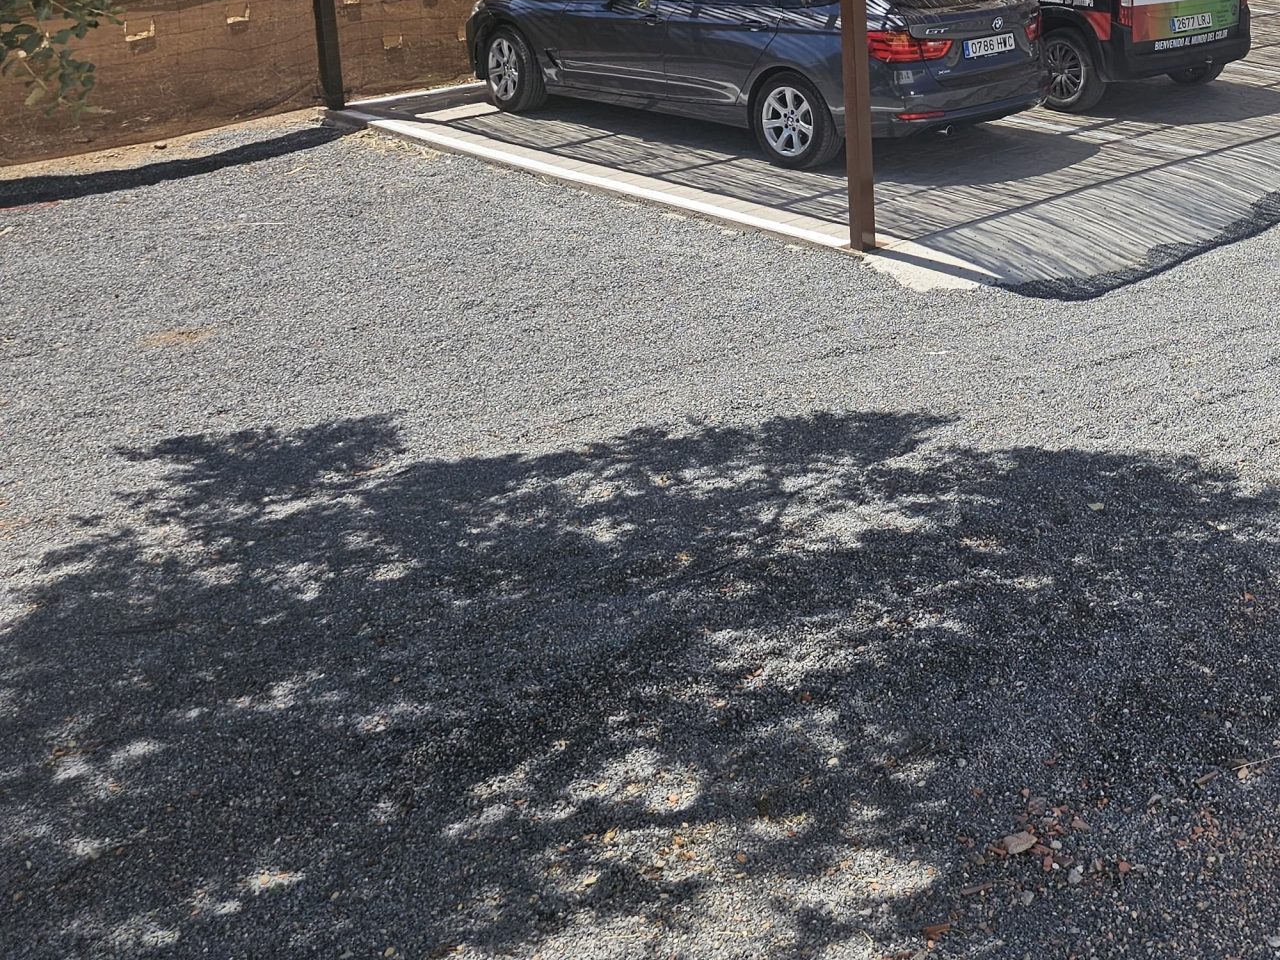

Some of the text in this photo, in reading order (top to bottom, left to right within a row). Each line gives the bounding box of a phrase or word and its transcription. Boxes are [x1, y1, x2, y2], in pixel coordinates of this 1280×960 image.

[1177, 14, 1211, 30] 2677 LRJ
[971, 39, 995, 54] 0786
[1154, 37, 1184, 51] BIENVENIDO
[1207, 31, 1215, 42] DEL
[1215, 29, 1228, 40] COLOR
